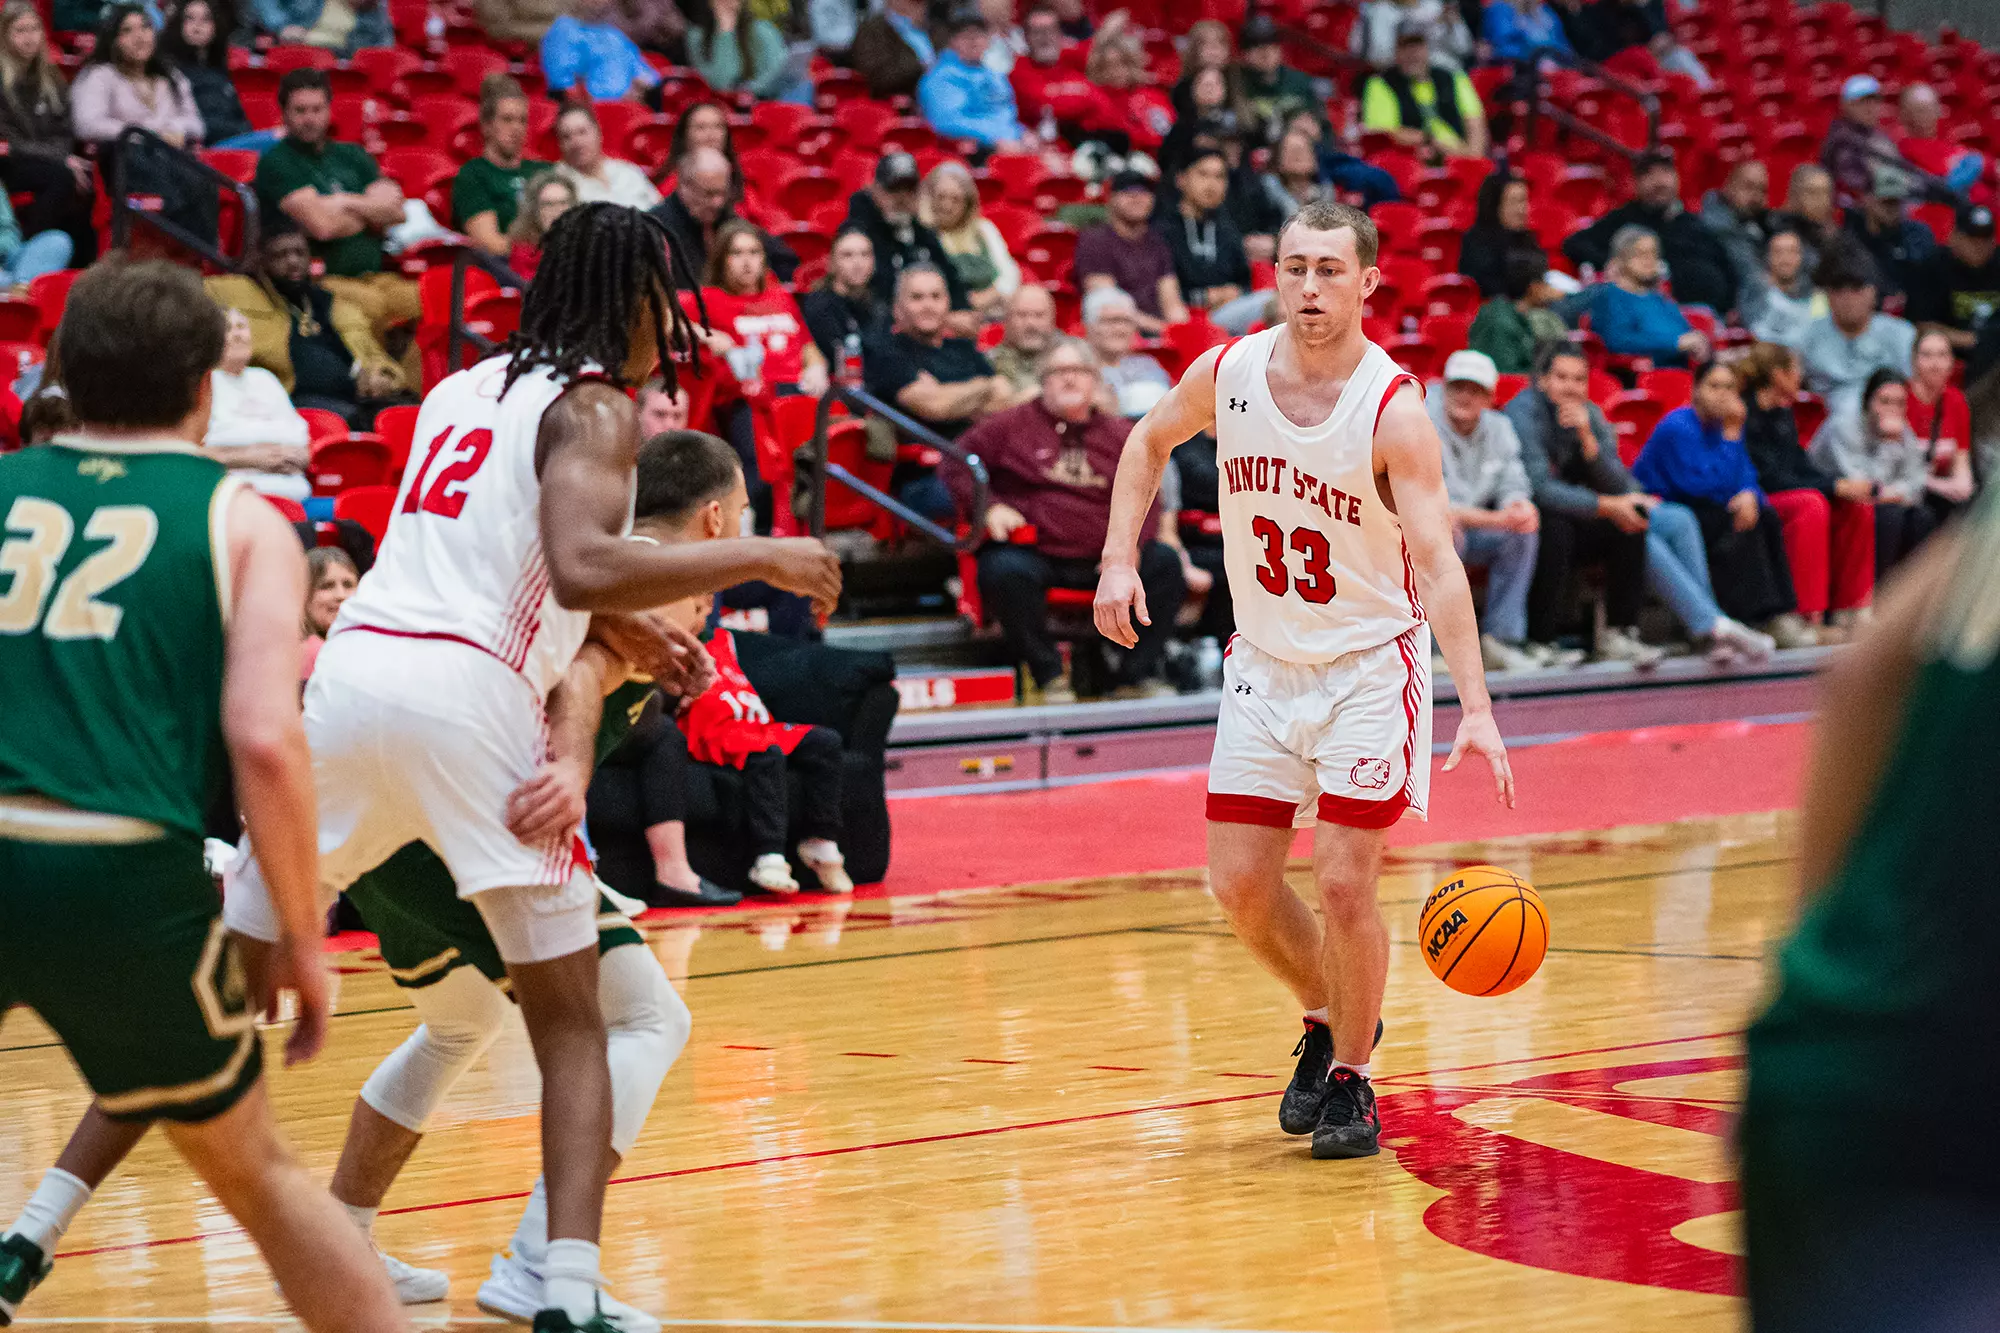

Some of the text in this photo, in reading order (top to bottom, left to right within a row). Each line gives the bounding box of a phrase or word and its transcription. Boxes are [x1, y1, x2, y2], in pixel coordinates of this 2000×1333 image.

[401, 424, 493, 519] 12
[1293, 466, 1362, 526] STATE
[0, 496, 159, 643] 32
[1252, 515, 1337, 605] 33
[1427, 909, 1468, 962] NCAA
